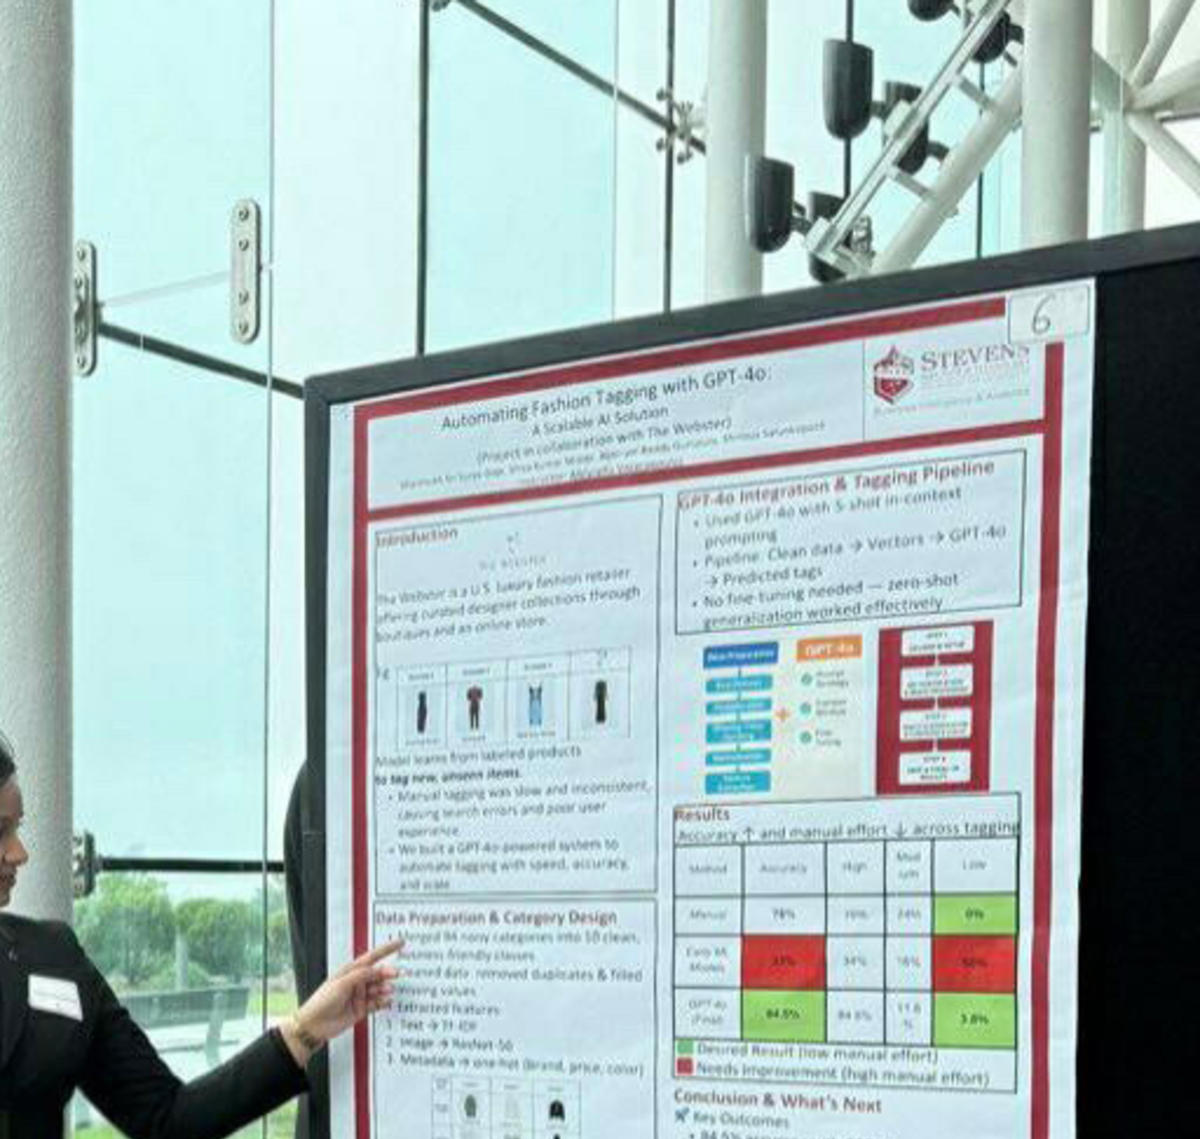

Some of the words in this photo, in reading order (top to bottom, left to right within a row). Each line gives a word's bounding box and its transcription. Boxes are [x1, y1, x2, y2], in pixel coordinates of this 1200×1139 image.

[1031, 293, 1055, 334] 6
[921, 344, 1030, 371] STEVENS
[442, 405, 529, 430] Automating
[532, 392, 591, 418] Fashion
[596, 384, 657, 405] Tagging
[662, 375, 700, 394] with
[703, 365, 772, 388] GPT-4o:
[532, 425, 541, 436] A
[543, 417, 594, 434] Scalable
[614, 406, 669, 425] Solution
[617, 430, 644, 443] with
[648, 427, 669, 439] The
[672, 417, 732, 436] Webster)
[678, 493, 734, 509] GPT-4o
[740, 480, 830, 505] Integration
[833, 477, 847, 492] &
[855, 469, 918, 489] Tagging
[922, 461, 995, 482] Pipeline
[799, 501, 831, 516] with
[376, 528, 458, 546] Introduction
[705, 529, 778, 550] prompting
[767, 547, 807, 562] Clean
[811, 542, 844, 557] data
[867, 533, 925, 550] Vectors
[723, 568, 791, 587] Predicted
[793, 565, 823, 581] tags
[589, 585, 641, 602] through
[704, 595, 724, 608] No
[808, 581, 864, 599] needed
[806, 602, 862, 620] worked
[864, 595, 944, 614] effectively
[545, 781, 569, 797] and
[520, 800, 544, 816] and
[675, 807, 730, 822] Results
[678, 829, 737, 843] Accuracy
[760, 826, 786, 839] and
[790, 823, 843, 839] manual
[847, 822, 888, 839] effort
[913, 821, 960, 835] across
[964, 820, 1020, 838] tagging
[376, 911, 406, 924] Data
[409, 911, 486, 927] Preparation
[489, 911, 500, 924] &
[503, 909, 565, 928] Category
[568, 910, 618, 926] Design
[890, 1049, 939, 1065] effort)
[697, 1061, 739, 1075] Needs
[841, 1066, 878, 1084] (high
[882, 1069, 938, 1083] manual
[942, 1070, 990, 1088] effort)
[674, 1088, 759, 1107] Conclusion
[763, 1093, 775, 1107] &
[780, 1094, 839, 1112] What's
[843, 1096, 883, 1114] Next
[693, 1111, 716, 1126] Key
[719, 1111, 790, 1130] Outcomes
